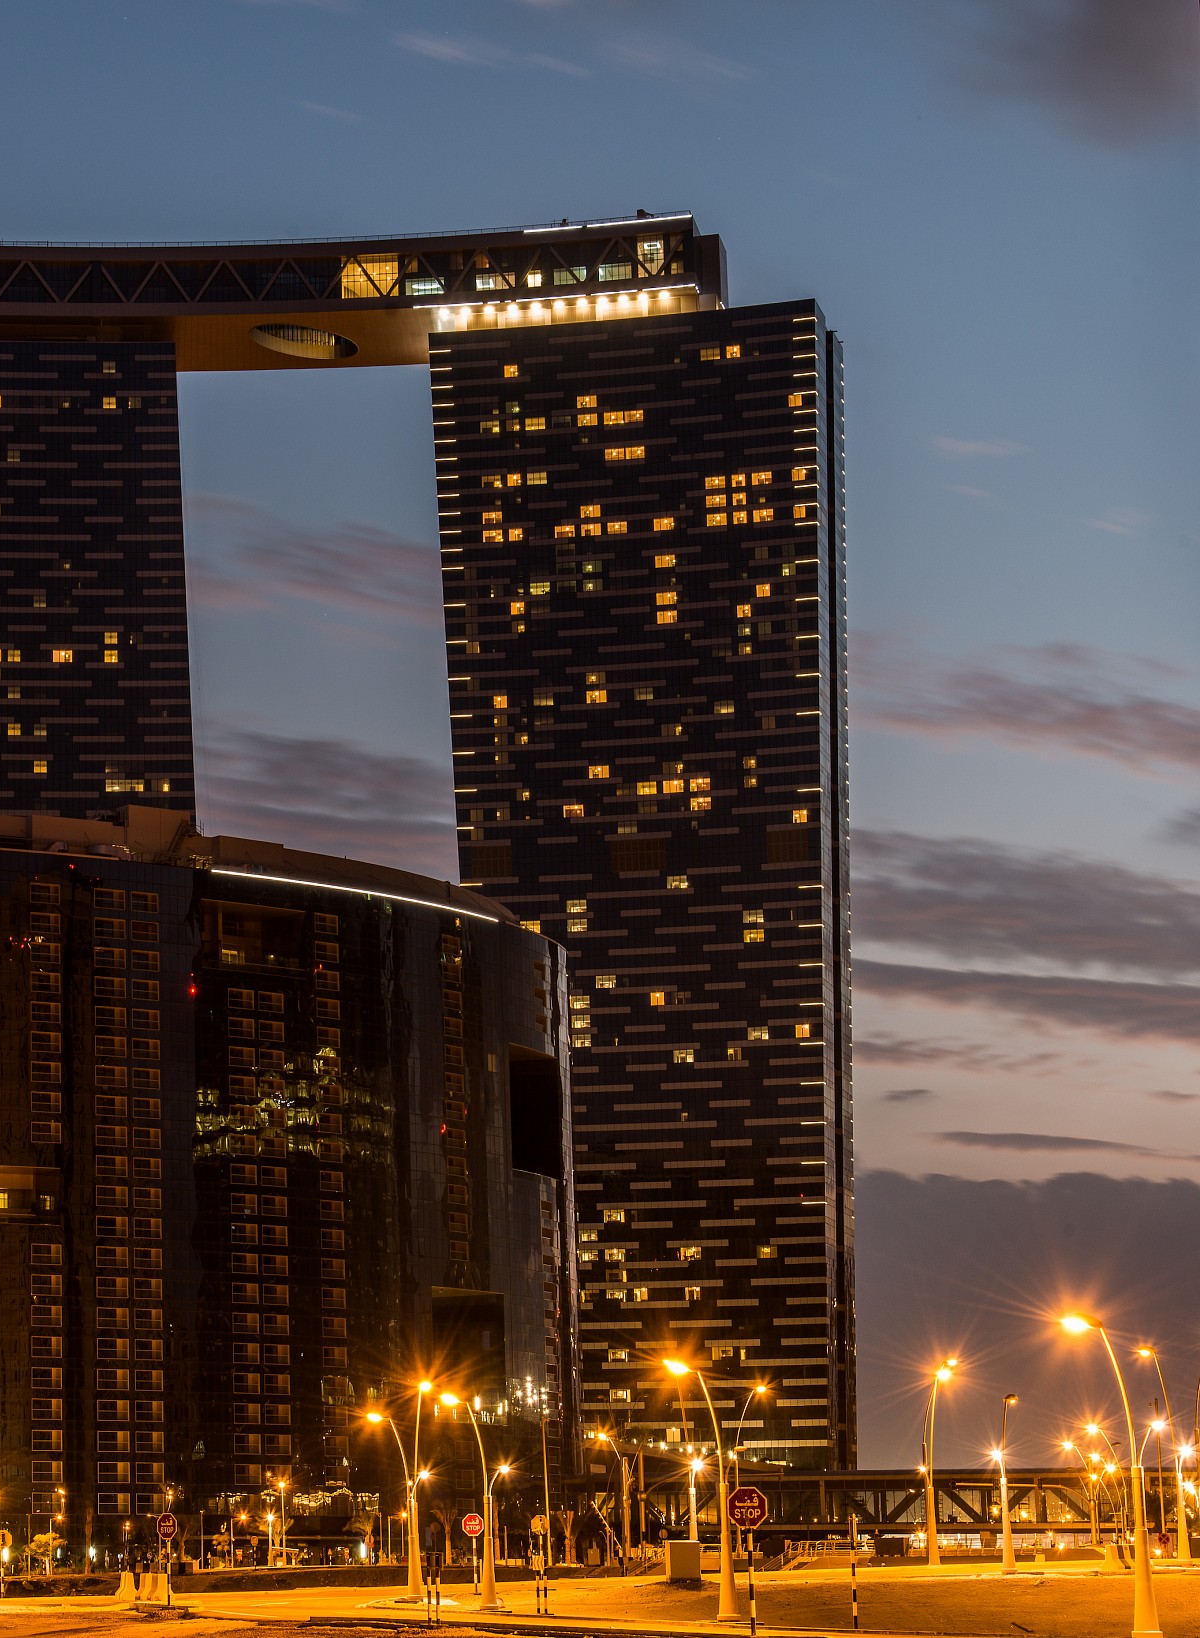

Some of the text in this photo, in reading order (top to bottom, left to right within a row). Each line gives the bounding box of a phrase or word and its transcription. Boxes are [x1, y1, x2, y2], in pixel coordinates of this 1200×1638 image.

[735, 1494, 759, 1506] قف
[734, 1508, 761, 1519] STOP
[160, 1526, 174, 1534] STOP
